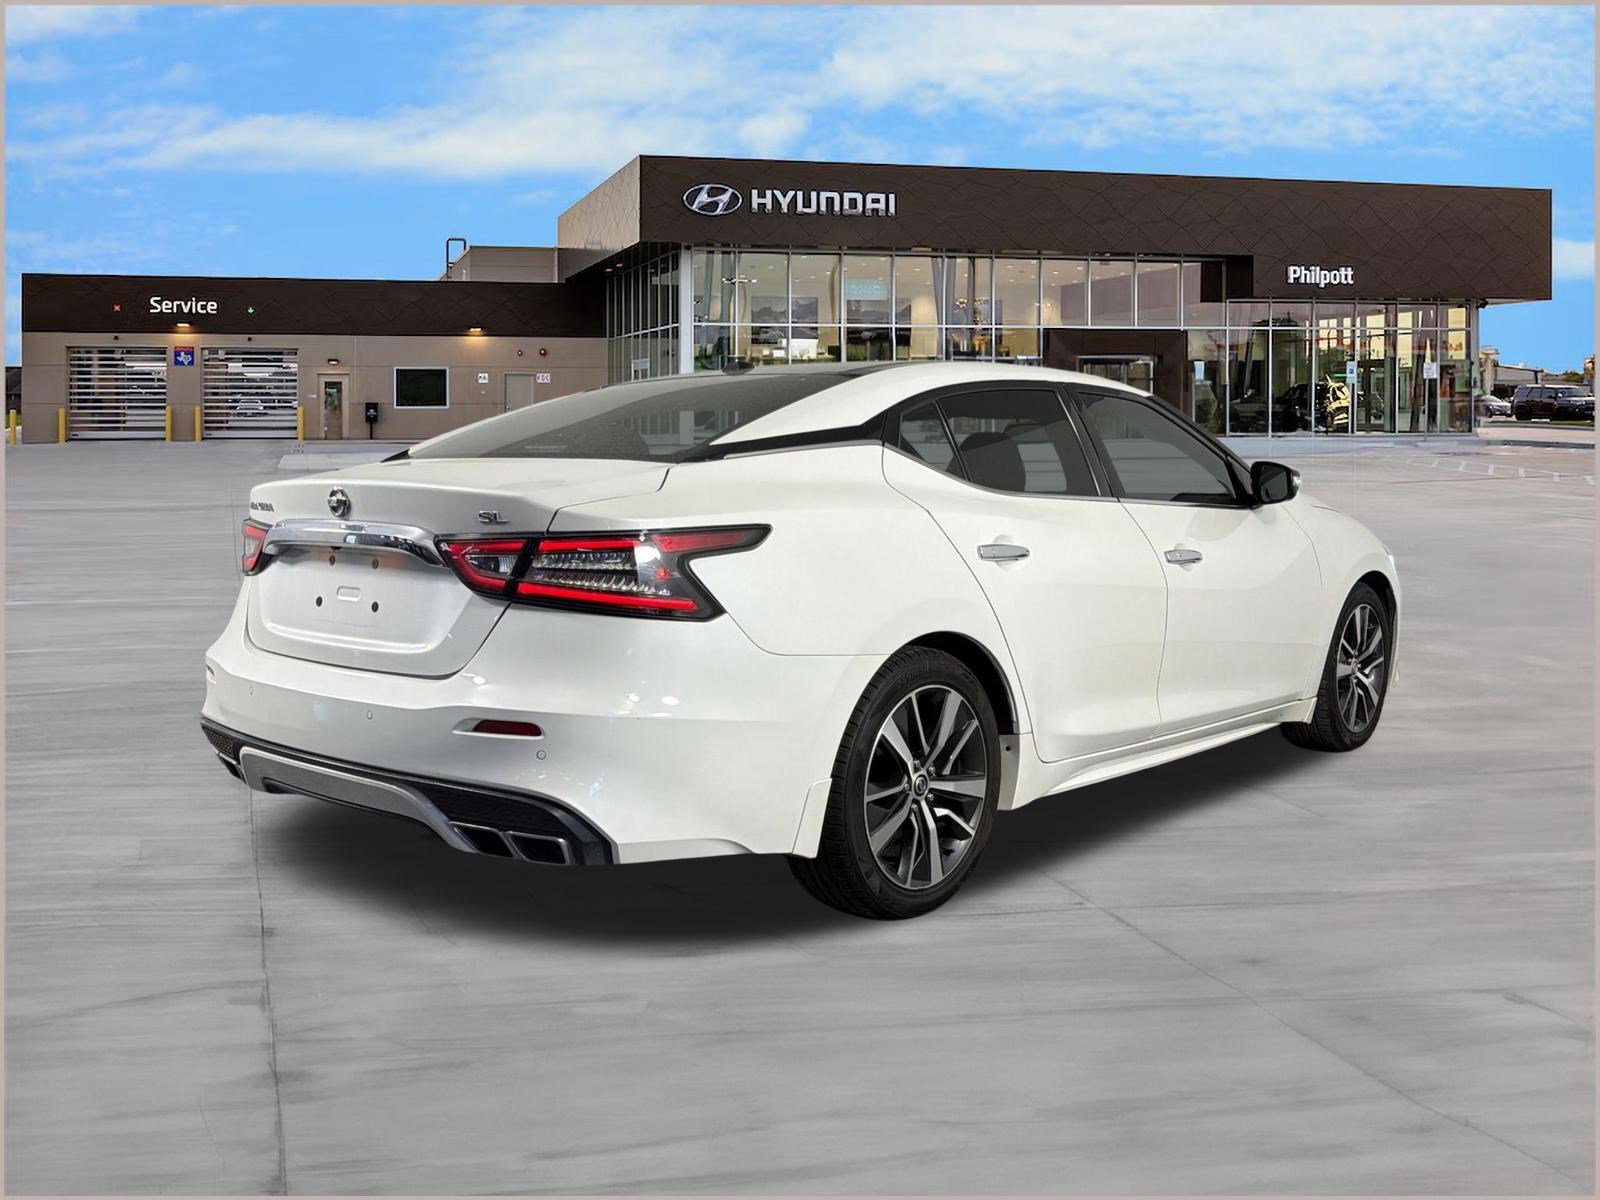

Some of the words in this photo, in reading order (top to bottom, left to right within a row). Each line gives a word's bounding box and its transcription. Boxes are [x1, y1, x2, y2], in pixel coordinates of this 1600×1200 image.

[751, 188, 896, 217] HYUNDAI
[1287, 265, 1354, 288] Philpott
[149, 296, 218, 314] Service
[479, 510, 510, 525] SL
